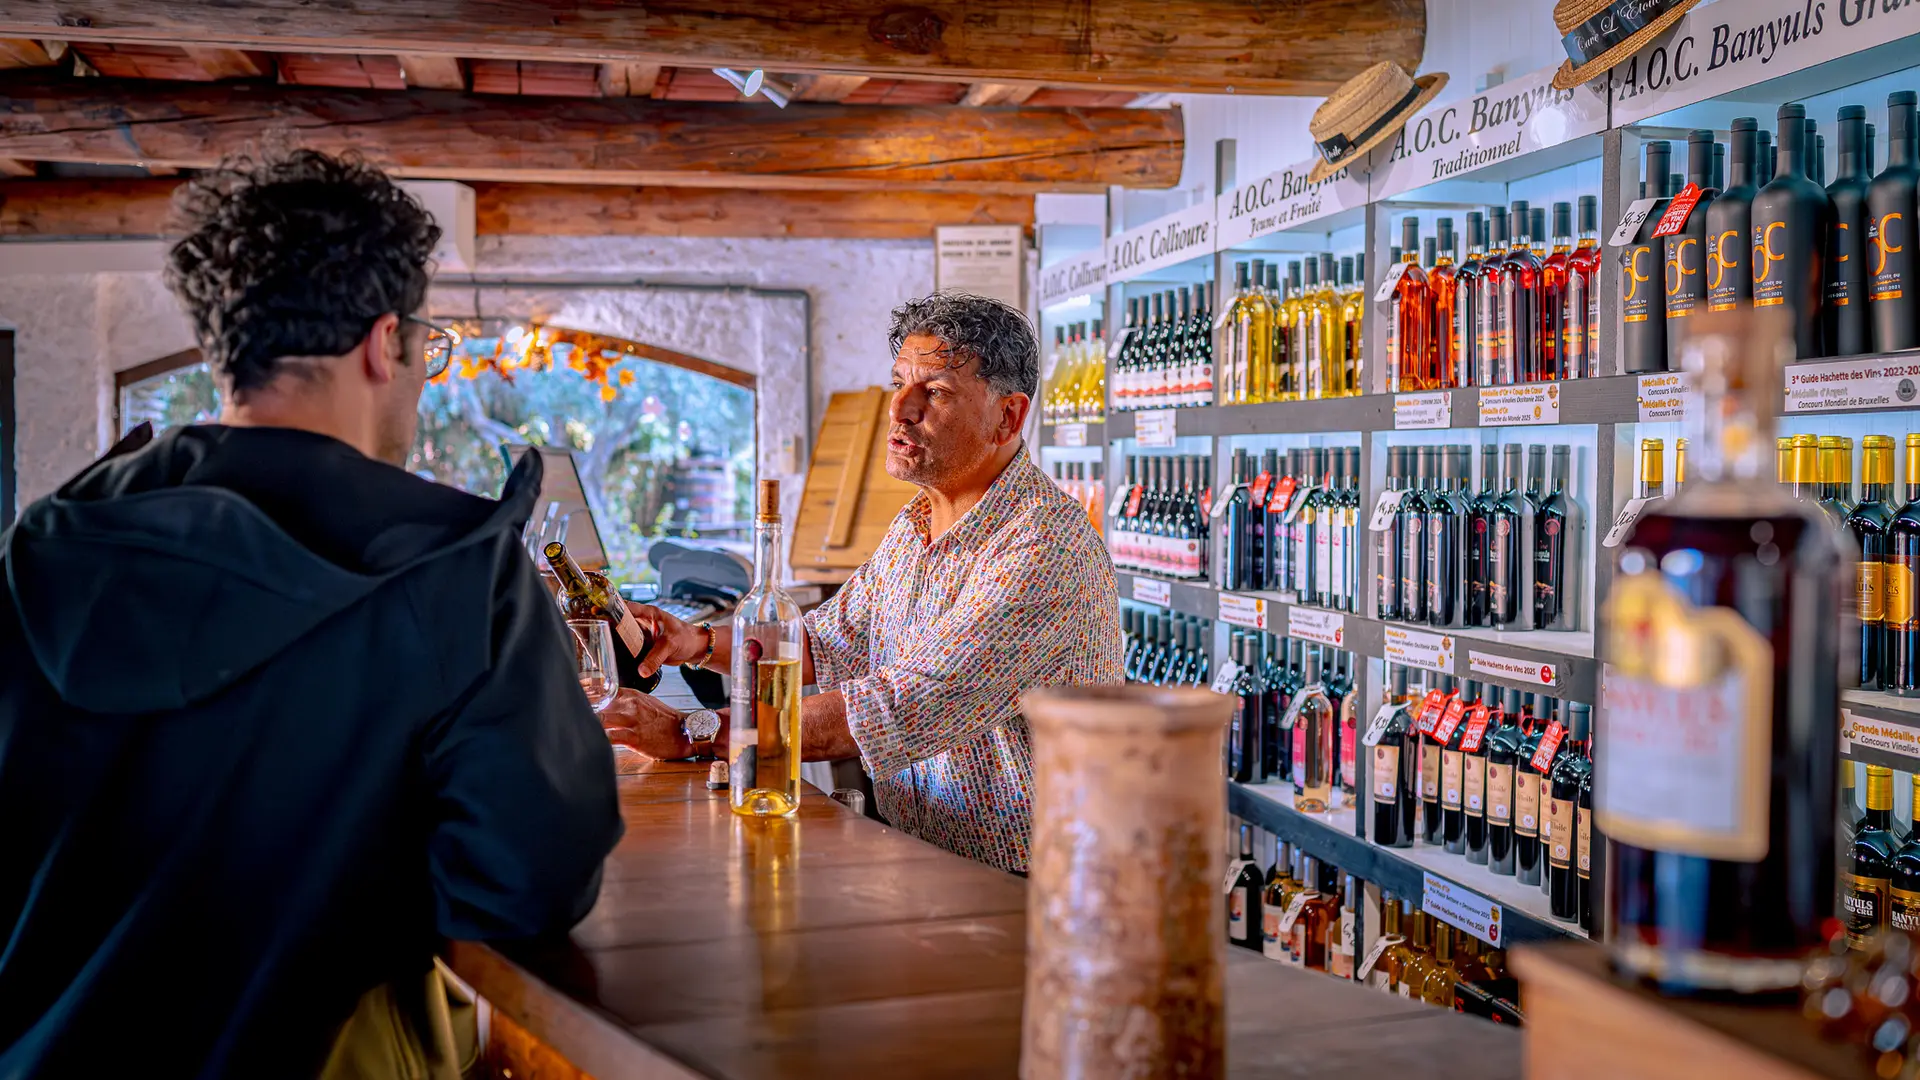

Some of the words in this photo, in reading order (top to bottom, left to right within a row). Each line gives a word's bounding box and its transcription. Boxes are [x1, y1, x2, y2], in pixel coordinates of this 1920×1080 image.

[1619, 36, 1699, 101] A.O.C.
[1707, 0, 1826, 64] Banyuls
[1390, 108, 1460, 163] A.O.C.
[1432, 131, 1521, 179] Traditionnel
[1229, 178, 1275, 219] A.O.C.
[1249, 216, 1276, 238] Jeune
[1278, 213, 1287, 225] et
[1290, 196, 1322, 221] Fruité
[1109, 236, 1145, 274] A.O.C.
[1149, 219, 1209, 260] Collioure
[1641, 377, 1665, 387] Médaille
[1666, 376, 1679, 385] d'Or
[1801, 374, 1819, 384] Guide
[1820, 371, 1849, 382] Hachette
[1850, 370, 1863, 380] des
[1864, 369, 1882, 379] Vins
[1648, 388, 1670, 396] Concours
[1791, 388, 1819, 399] Médaille
[1820, 386, 1848, 398] d'Argent
[1642, 399, 1667, 408] Médaille
[1667, 398, 1680, 407] d'Or
[1797, 400, 1824, 409] Concours
[1824, 398, 1848, 407] Mondial
[1849, 397, 1857, 406] de
[1858, 395, 1890, 405] Bruxelles
[1648, 410, 1671, 418] Concours
[1852, 721, 1879, 736] Grande
[1881, 727, 1915, 743] Médaille
[1860, 735, 1890, 748] Concours
[1892, 740, 1919, 754] Vinalies
